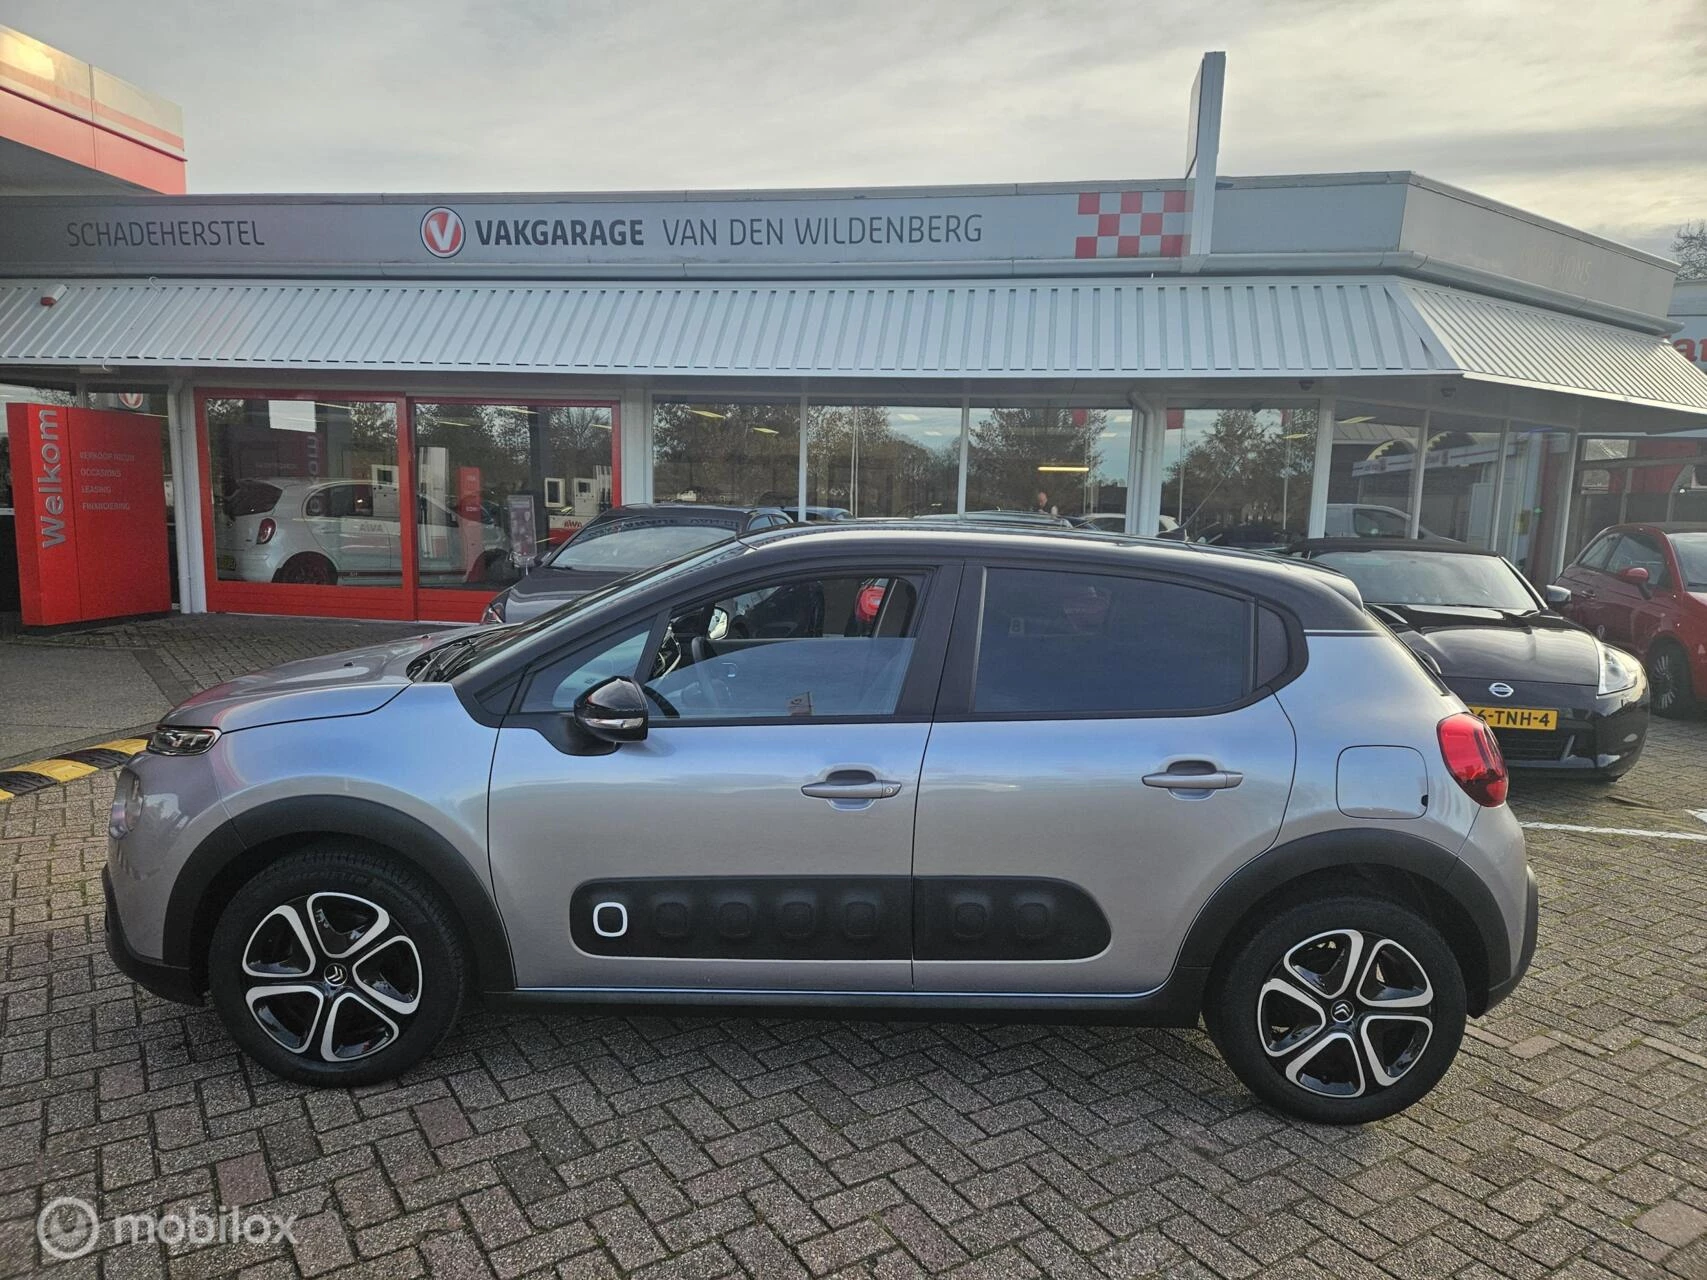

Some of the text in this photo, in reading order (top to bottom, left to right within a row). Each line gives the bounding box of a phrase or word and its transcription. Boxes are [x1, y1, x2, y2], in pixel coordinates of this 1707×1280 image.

[67, 220, 265, 247] SCHADEHERSTEL
[475, 219, 645, 246] VAKGARAGE
[662, 218, 717, 246] VAN
[730, 217, 784, 246] DEN
[794, 214, 983, 245] WILDENBERG
[38, 409, 66, 548] Welkom
[1470, 708, 1550, 727] 6-TNH-4
